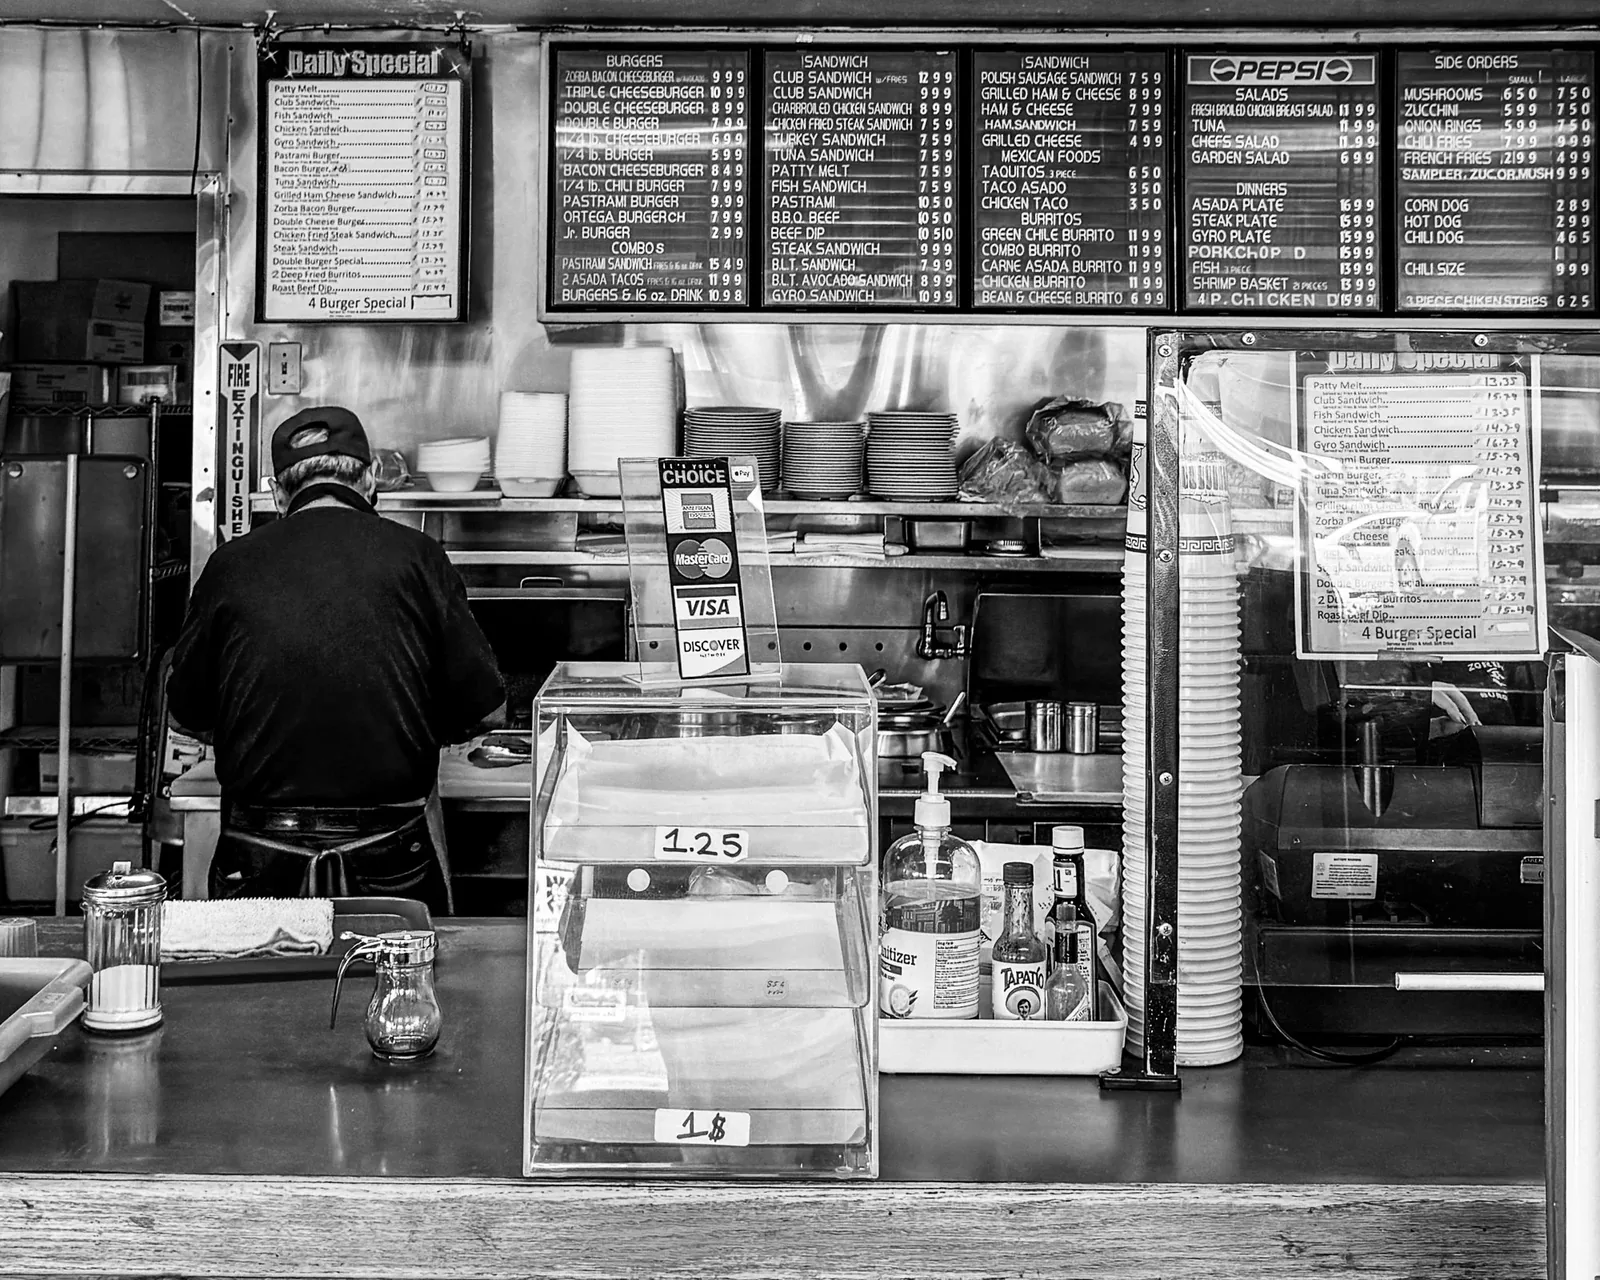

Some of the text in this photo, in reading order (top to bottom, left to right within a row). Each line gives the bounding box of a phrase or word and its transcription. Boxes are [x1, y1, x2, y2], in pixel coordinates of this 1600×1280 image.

[288, 50, 438, 76] Daily Special
[607, 55, 663, 67] BURGERS
[804, 56, 867, 67] SANDWICH
[1026, 57, 1088, 68] SANDWICH
[1435, 56, 1518, 69] SIDE ORDERS
[1236, 61, 1325, 80] PEPSI
[773, 71, 804, 83] CLUB
[808, 71, 871, 83] SANDWICH
[982, 72, 1121, 85] POLISH SAUSAGE SANDWICH
[1509, 76, 1533, 84] SMALL
[274, 85, 317, 93] Patty Melt
[566, 86, 704, 98] TRIPLE CHEESEBURGER
[982, 88, 1121, 100] GRILLED HAM & CHEESE
[1236, 88, 1288, 101] SALADS
[1405, 88, 1483, 101] MUSHROOMS
[564, 102, 704, 114] DOUBLE CHEESEBURGER
[1405, 104, 1458, 116] ZUCCHINI
[1192, 120, 1225, 132] TUNA
[1405, 120, 1481, 132] ONION RINGS
[274, 138, 336, 147] Gyro Sandwich
[982, 134, 1081, 146] GRILLED CHEESE
[312, 152, 340, 160] Burger
[773, 149, 874, 161] TUNA SANDWICH
[1002, 150, 1100, 163] MEXICAN FOODS
[1192, 152, 1289, 164] GARDEN SALAD
[1404, 152, 1491, 164] FRENCH FRIES
[564, 164, 703, 176] BACON CHEESEBURGER
[772, 165, 849, 176] PATTY MELT
[982, 165, 1044, 178] TAQUITOS
[1056, 170, 1076, 178] PIECE
[605, 180, 632, 192] CHILI
[637, 180, 684, 192] BURGER
[772, 180, 866, 192] FISH SANDWICH
[982, 181, 1066, 194] TACO ASADO
[1237, 183, 1287, 195] DINNERS
[563, 196, 678, 207] PASTRAMI BURGER
[772, 196, 835, 208] PASTRAMI
[982, 197, 1068, 209] CHICKEN TACO
[1192, 198, 1284, 211] ASADA PLATE
[1405, 199, 1469, 212] CORN DOG
[328, 205, 354, 214] Burger
[1022, 213, 1082, 225] BURRITOS
[1405, 215, 1461, 228] HOT DOG
[582, 227, 630, 238] BURGER
[771, 228, 825, 239] BEEF DIP
[982, 228, 1114, 241] GREEN CHILE BURRITO
[1192, 230, 1271, 243] GYRO PLATE
[1405, 231, 1464, 243] CHILI DOG
[772, 243, 880, 255] STEAK SANDWICH
[305, 258, 332, 266] Burger
[334, 257, 364, 266] Special
[982, 259, 1122, 273] CARNE ASADA BURRITO
[1193, 262, 1219, 274] FISH
[1405, 262, 1465, 275] CHILI SIZE
[563, 274, 643, 285] 2 ASADA TACOS
[1194, 277, 1288, 290] SHRIMP BASKET
[272, 284, 294, 292] Roast
[318, 284, 333, 293] Dip
[562, 289, 617, 301] BURGERS
[622, 289, 631, 301] &
[636, 289, 647, 301] 16
[671, 289, 703, 301] DRINK
[772, 290, 874, 302] GYRO SANDWICH
[982, 291, 1122, 304] BEAN & CHEESE BURRITO
[309, 297, 406, 311] 4 Burger Special
[228, 364, 250, 387] FIRE
[1314, 382, 1337, 390] Patty
[1314, 426, 1351, 434] Chicken
[1354, 426, 1399, 434] Sandwich
[1314, 441, 1385, 450] Gyro Sandwich
[232, 390, 245, 538] EXTINGUISHE
[663, 469, 726, 483] CHOICE
[676, 553, 730, 565] MasterCard
[686, 599, 730, 616] VISA
[1362, 625, 1476, 641] 4 Burger Special
[684, 639, 740, 652] DISCOVER
[663, 828, 743, 857] 1.25
